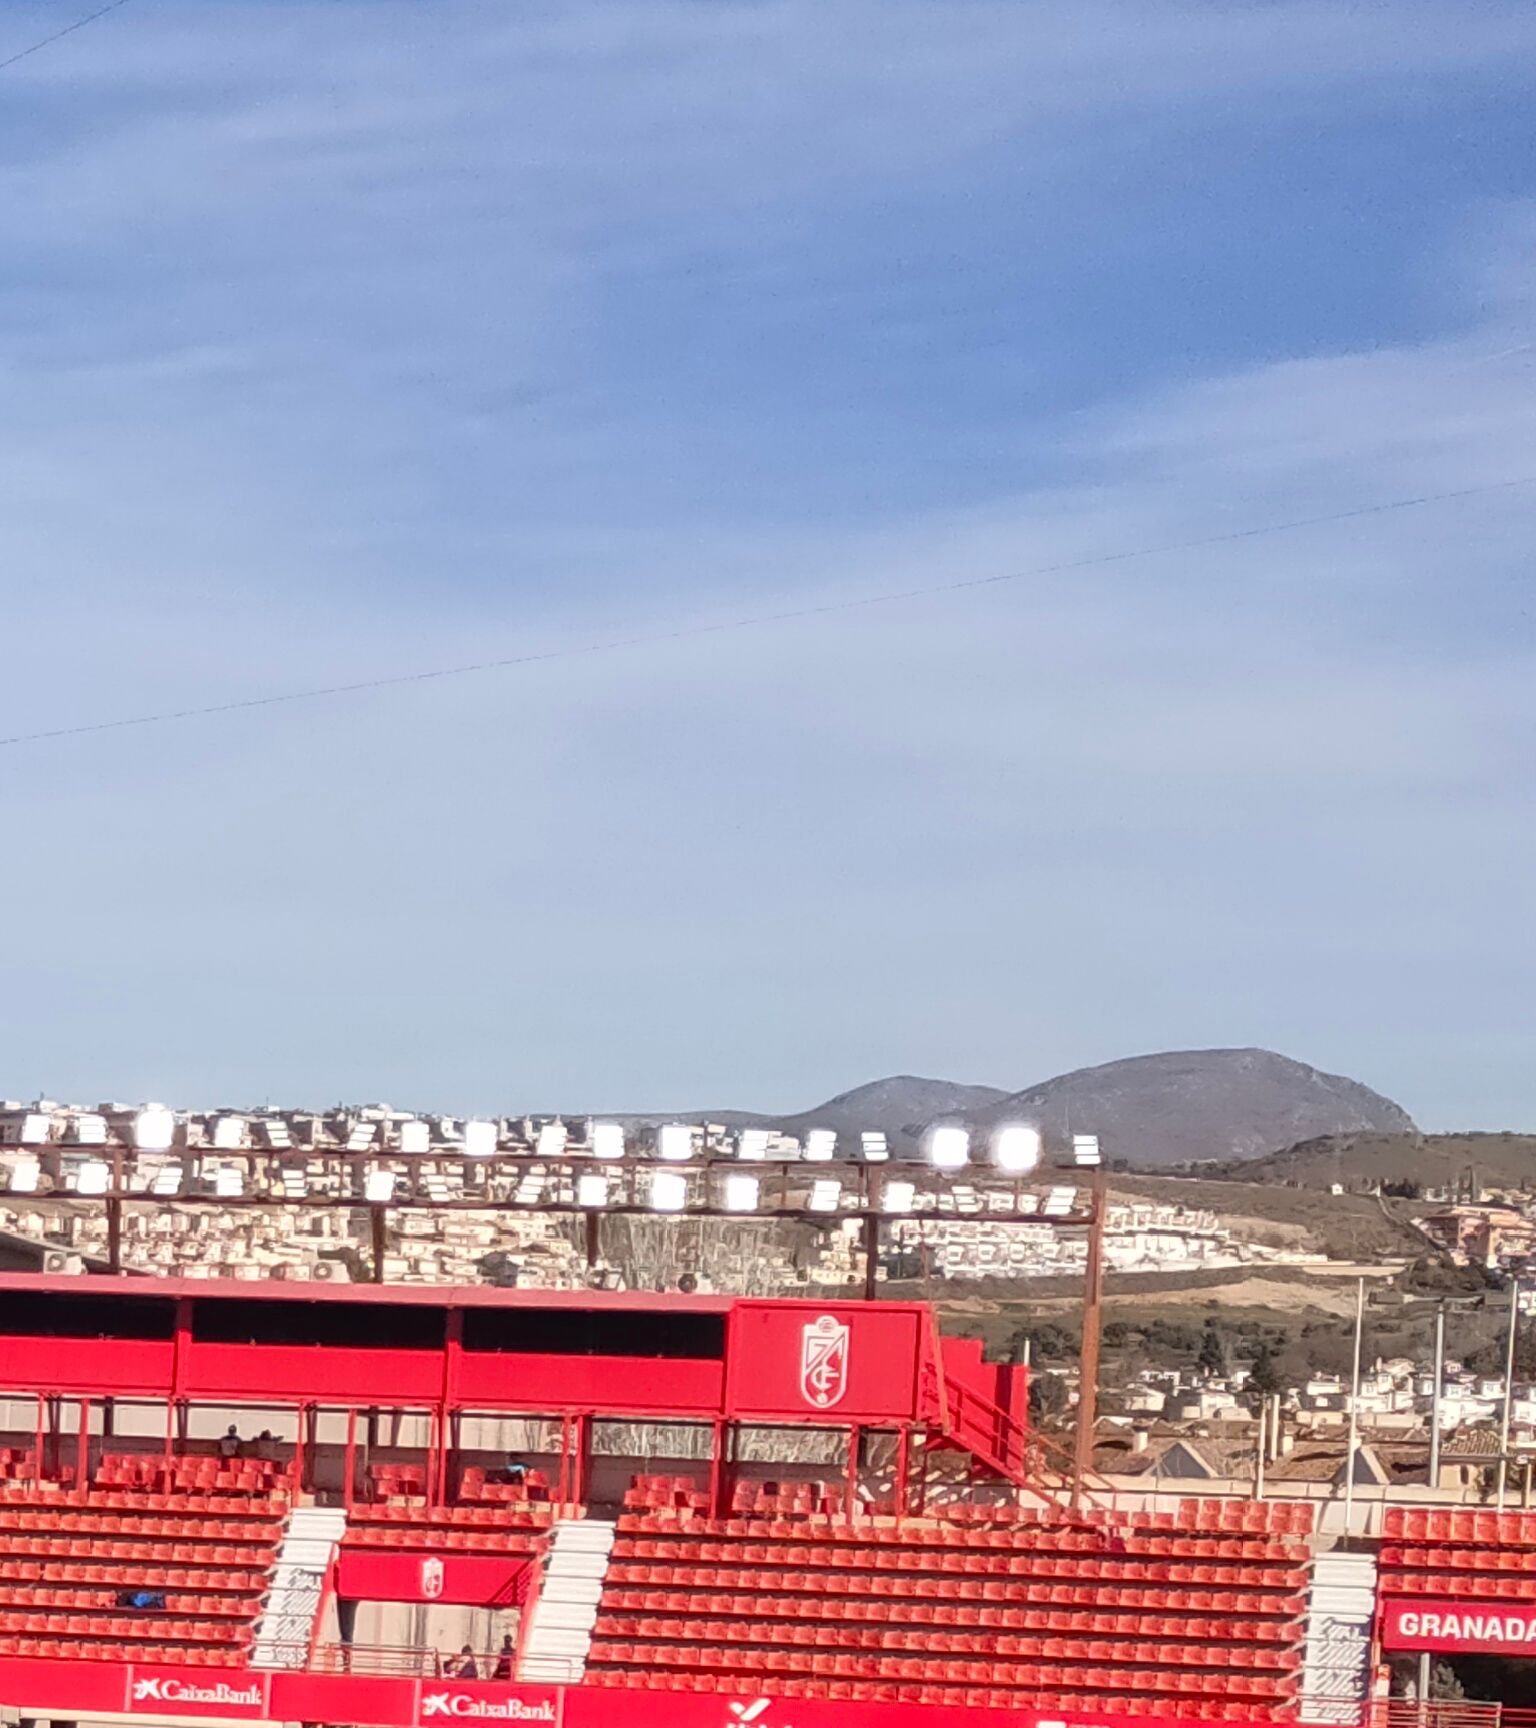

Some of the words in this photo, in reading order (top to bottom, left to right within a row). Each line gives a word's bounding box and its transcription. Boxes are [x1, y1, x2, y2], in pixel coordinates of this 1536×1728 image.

[1399, 1612, 1536, 1642] GRANADA
[162, 1679, 262, 1705] CaixaBank
[451, 1697, 555, 1721] CaixaBank
